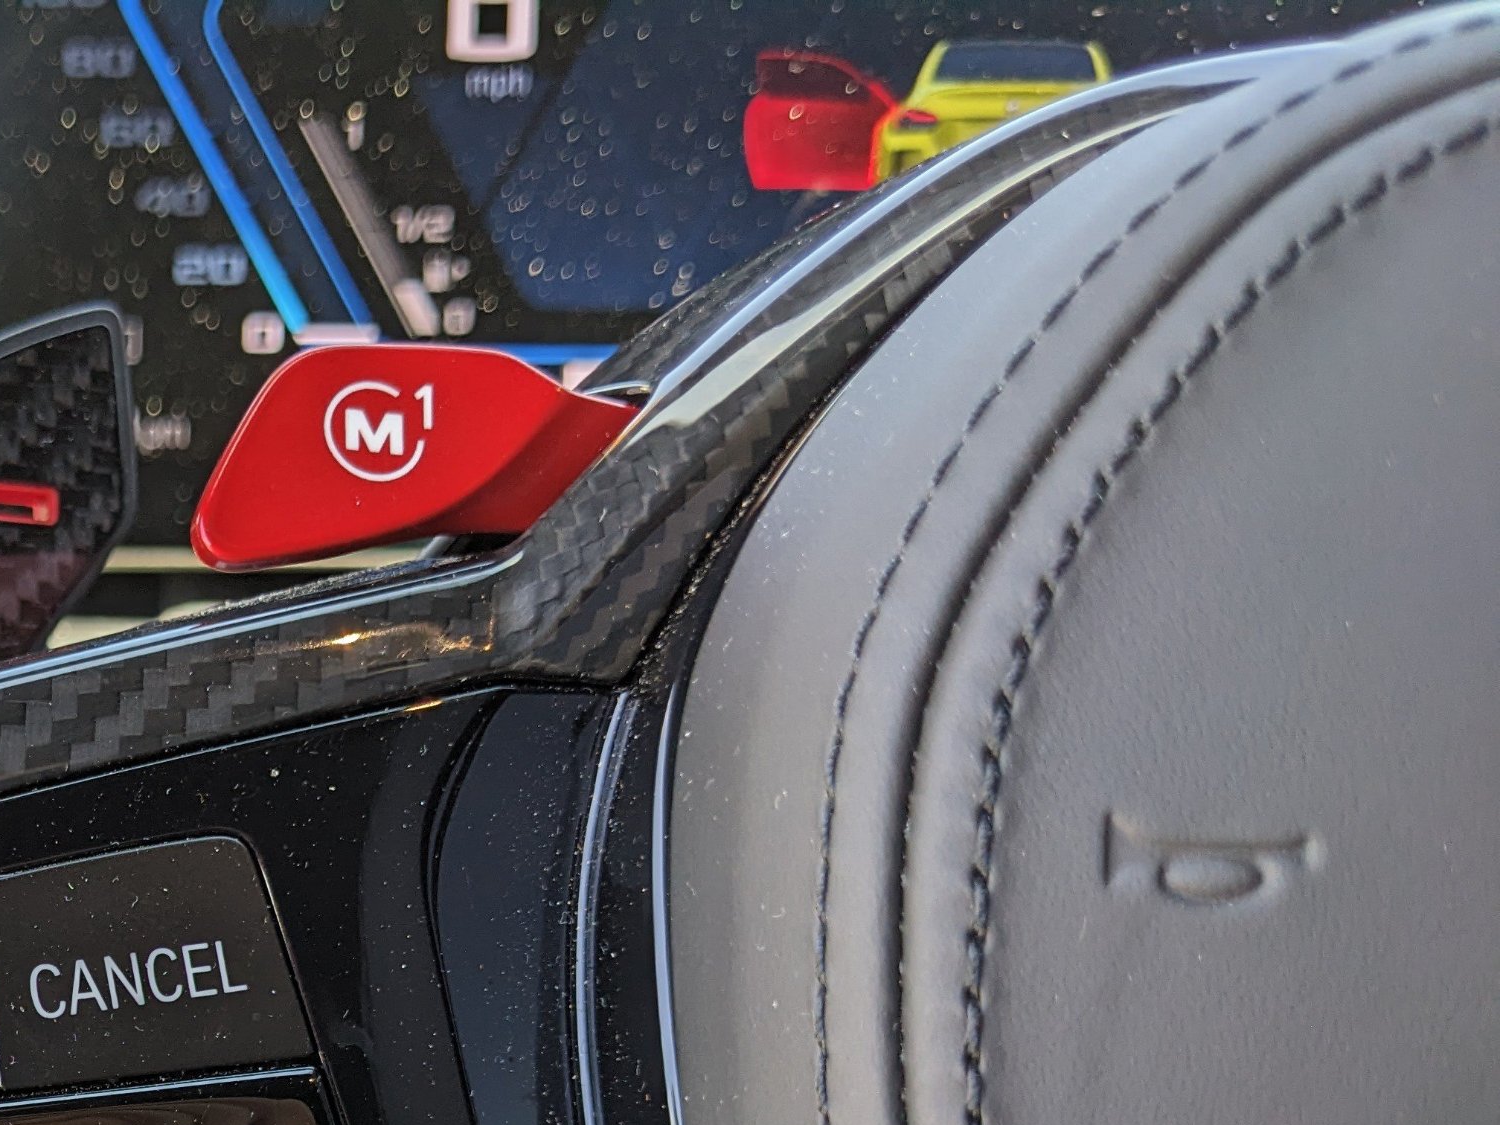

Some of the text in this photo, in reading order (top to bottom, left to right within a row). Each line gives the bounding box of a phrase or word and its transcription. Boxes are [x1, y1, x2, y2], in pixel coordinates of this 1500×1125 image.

[465, 64, 534, 103] mph
[172, 245, 248, 285] 20
[28, 939, 249, 1020] CANCEL
